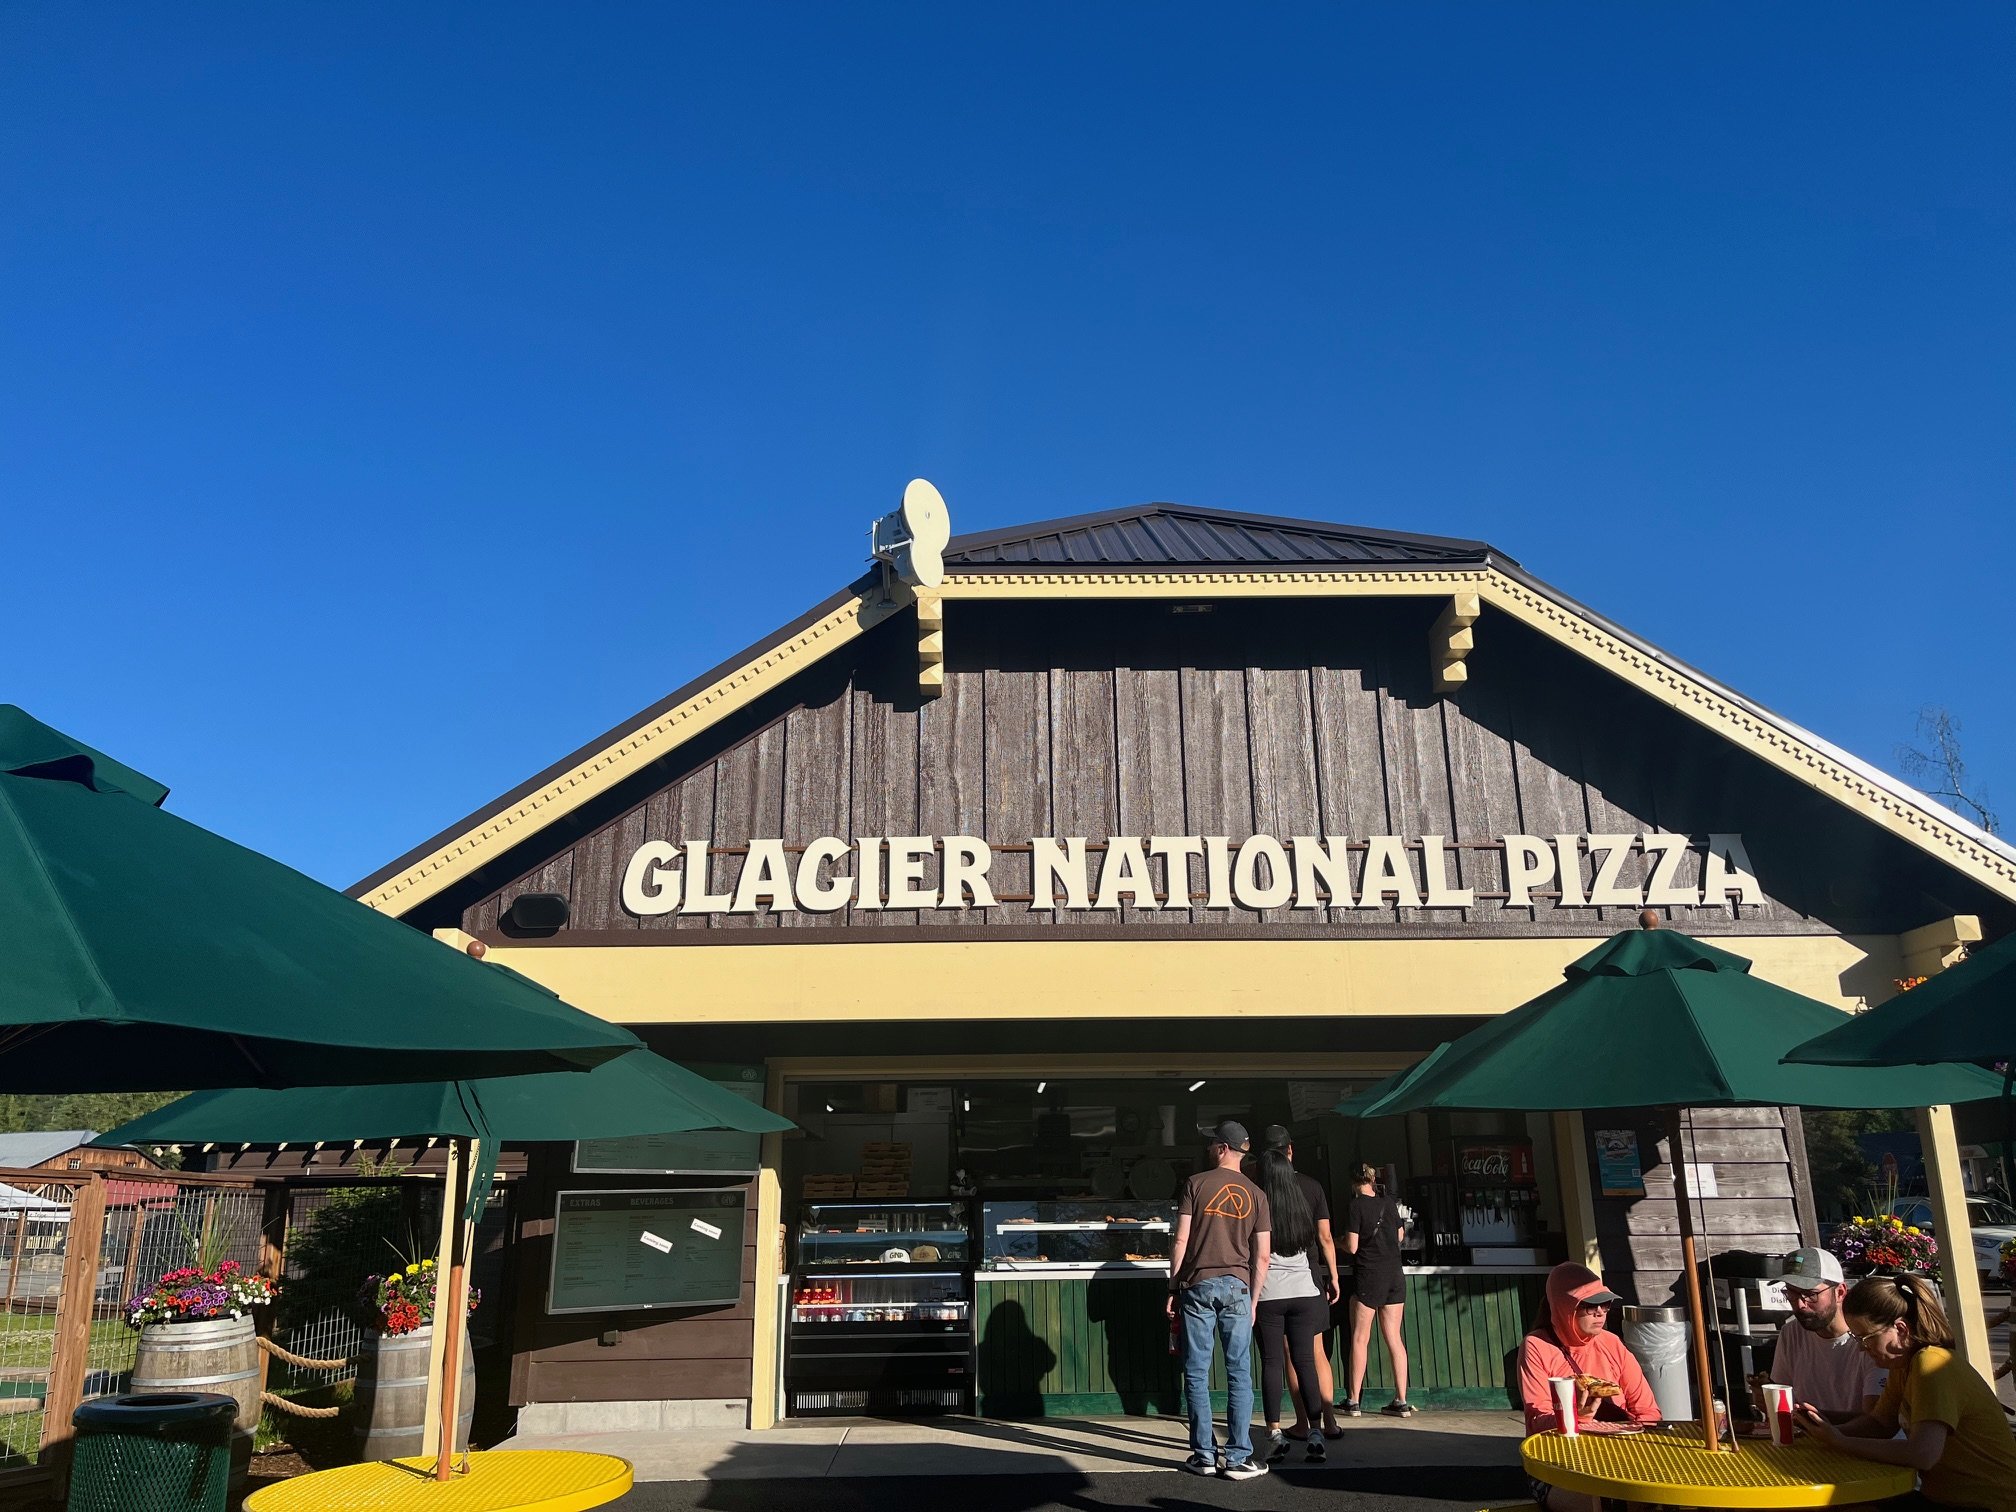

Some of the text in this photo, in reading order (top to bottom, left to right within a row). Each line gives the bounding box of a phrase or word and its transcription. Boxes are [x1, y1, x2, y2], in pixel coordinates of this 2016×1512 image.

[622, 832, 1768, 915] GLACIER NATIONAL PIZZA
[569, 1198, 601, 1208] EXTRAS
[630, 1197, 675, 1206] BEVERAGES
[694, 1222, 708, 1232] Coming
[643, 1235, 659, 1246] Coming
